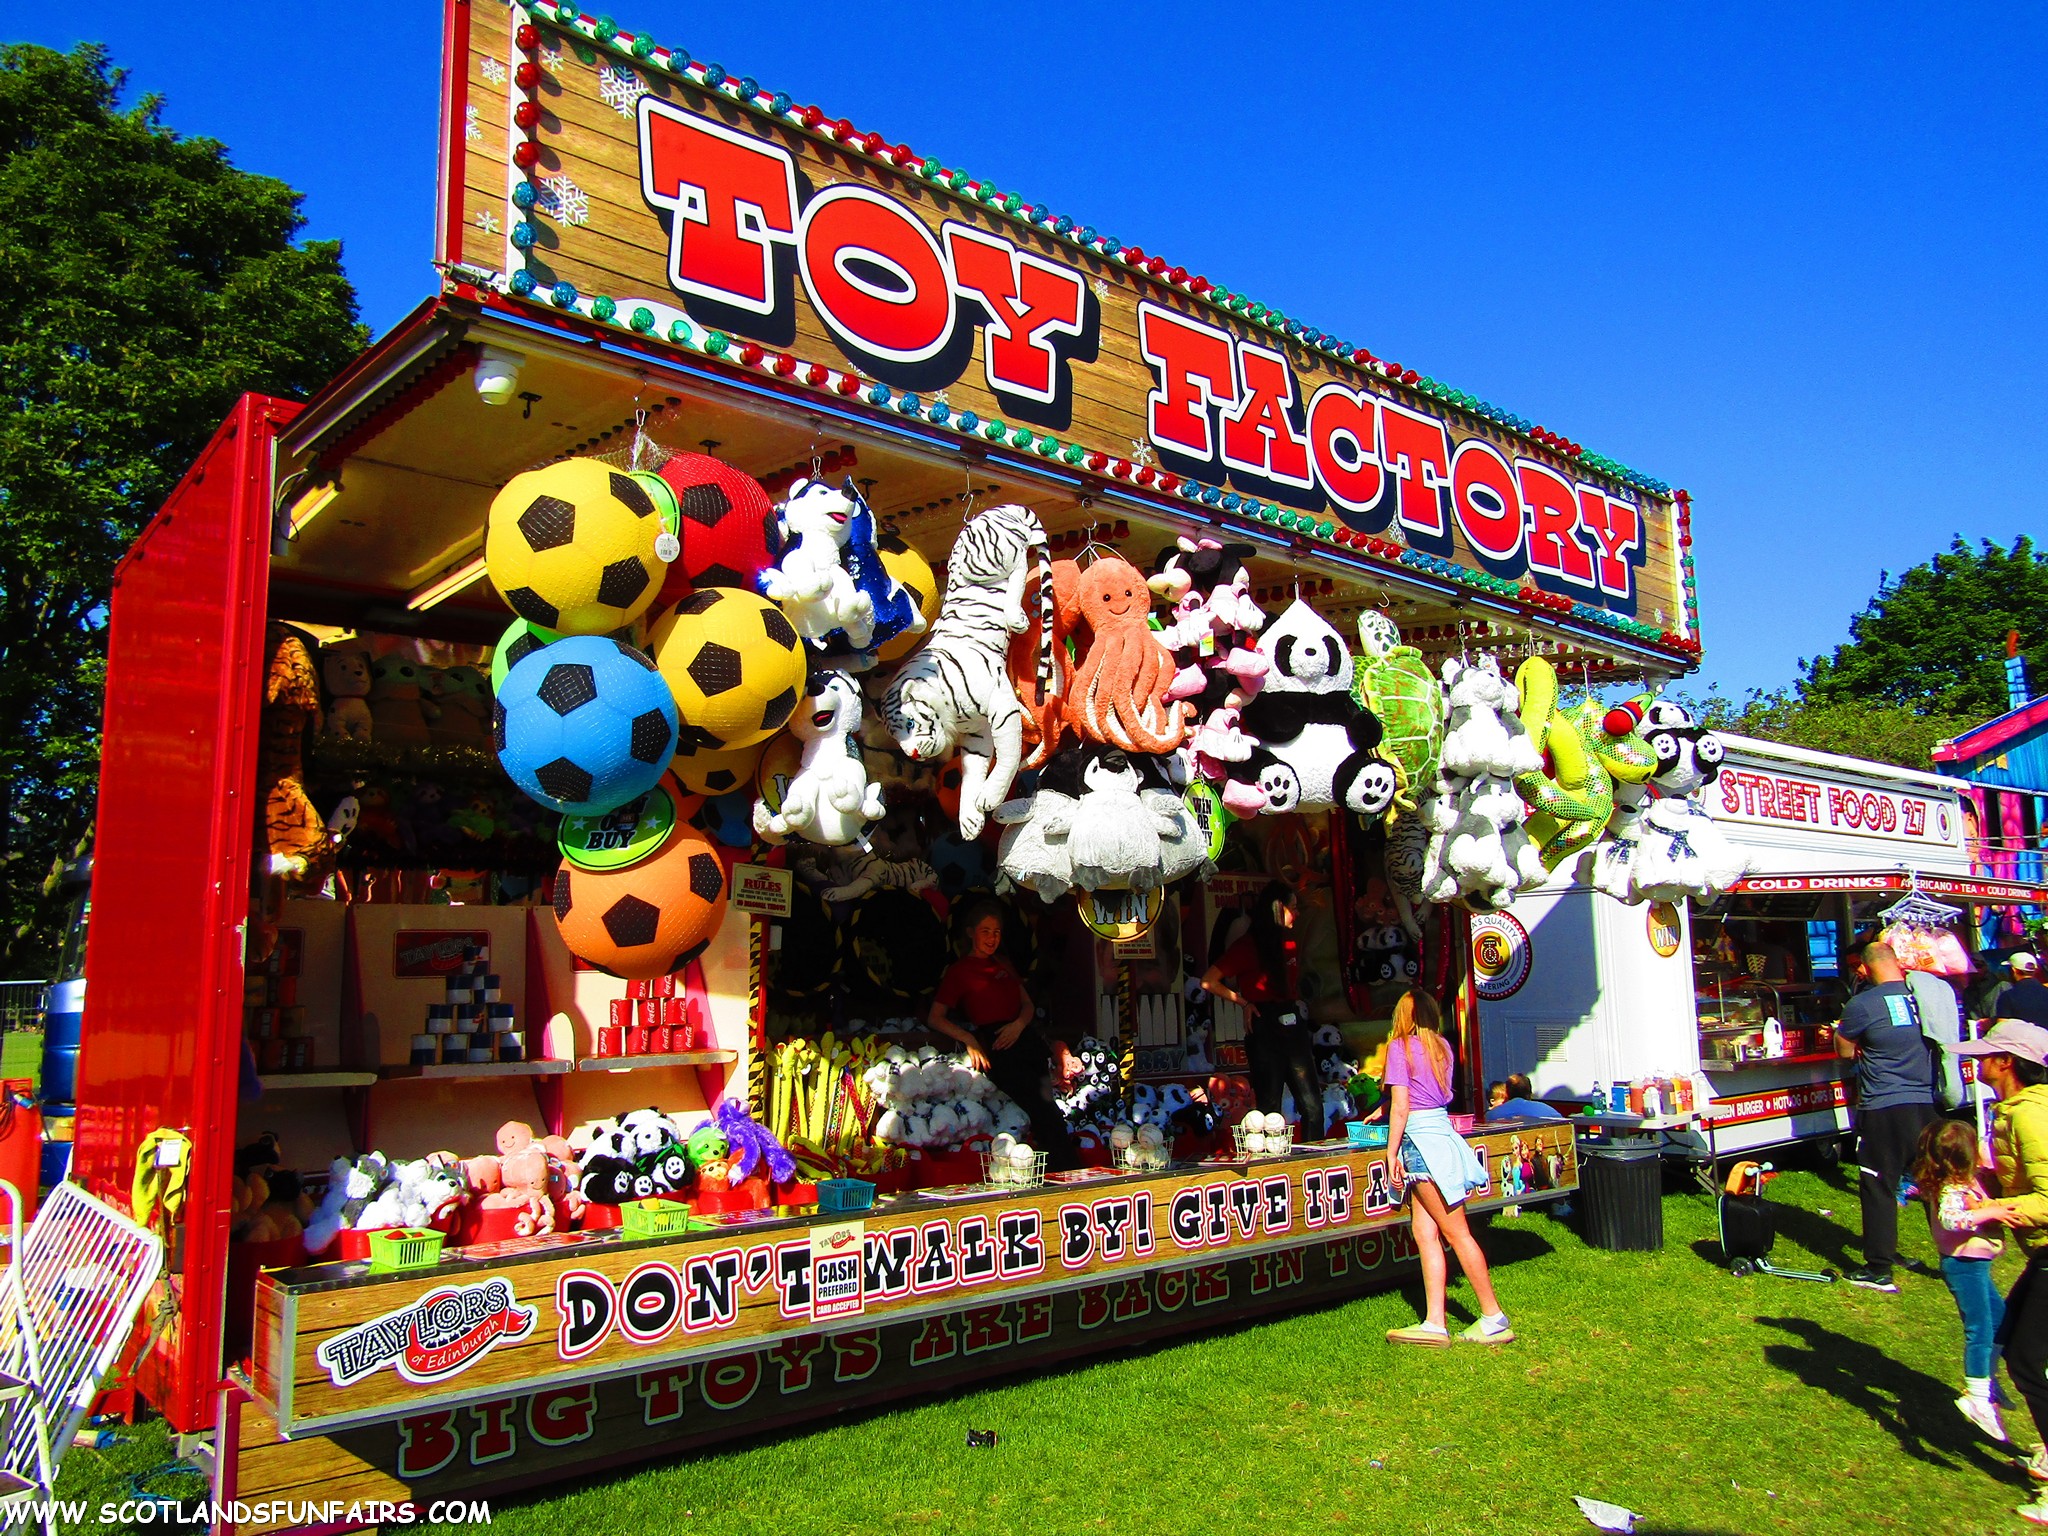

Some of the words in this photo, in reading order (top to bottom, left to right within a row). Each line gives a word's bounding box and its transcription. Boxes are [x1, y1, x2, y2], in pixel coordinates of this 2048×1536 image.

[638, 95, 1084, 403] TOY
[1137, 300, 1639, 601] FACTORY
[1193, 797, 1213, 814] WIN
[1720, 769, 1821, 823] STREET
[1827, 787, 1896, 832] FOOD
[1901, 799, 1926, 836] 27
[1198, 814, 1210, 830] OR
[585, 830, 636, 850] BUY
[744, 878, 782, 893] RULES
[1747, 877, 1802, 890] COLD
[1808, 876, 1887, 889] DRINKS
[1960, 884, 1977, 893] TEA
[1987, 886, 2006, 896] COLD
[2007, 888, 2031, 898] DRINKS
[1090, 893, 1149, 924] WIN
[1484, 916, 1518, 938] QUALITY
[1653, 926, 1679, 948] WIN
[1737, 1098, 1764, 1117] BURGER
[1810, 1089, 1828, 1104] CHIPS
[819, 1229, 851, 1249] TAYLORS
[562, 1243, 811, 1354] DON'T
[864, 1214, 1042, 1301] WALK
[1062, 1195, 1153, 1266] BY!
[1171, 1177, 1290, 1247] GIVE
[1303, 1166, 1351, 1226] IT
[818, 1258, 857, 1284] CASH
[818, 1282, 857, 1298] PREFERRED
[816, 1304, 832, 1315] CARD
[832, 1300, 860, 1312] ACCEPTED
[325, 1282, 507, 1379] TAYLORS
[398, 1382, 598, 1478] BIG
[637, 1327, 883, 1426] TOYS
[910, 1301, 1054, 1367] ARE
[1078, 1264, 1230, 1330] BACK
[1250, 1245, 1306, 1296] IN
[1325, 1225, 1451, 1278] TOW
[412, 1354, 425, 1366] of
[426, 1319, 499, 1370] Edinburgh
